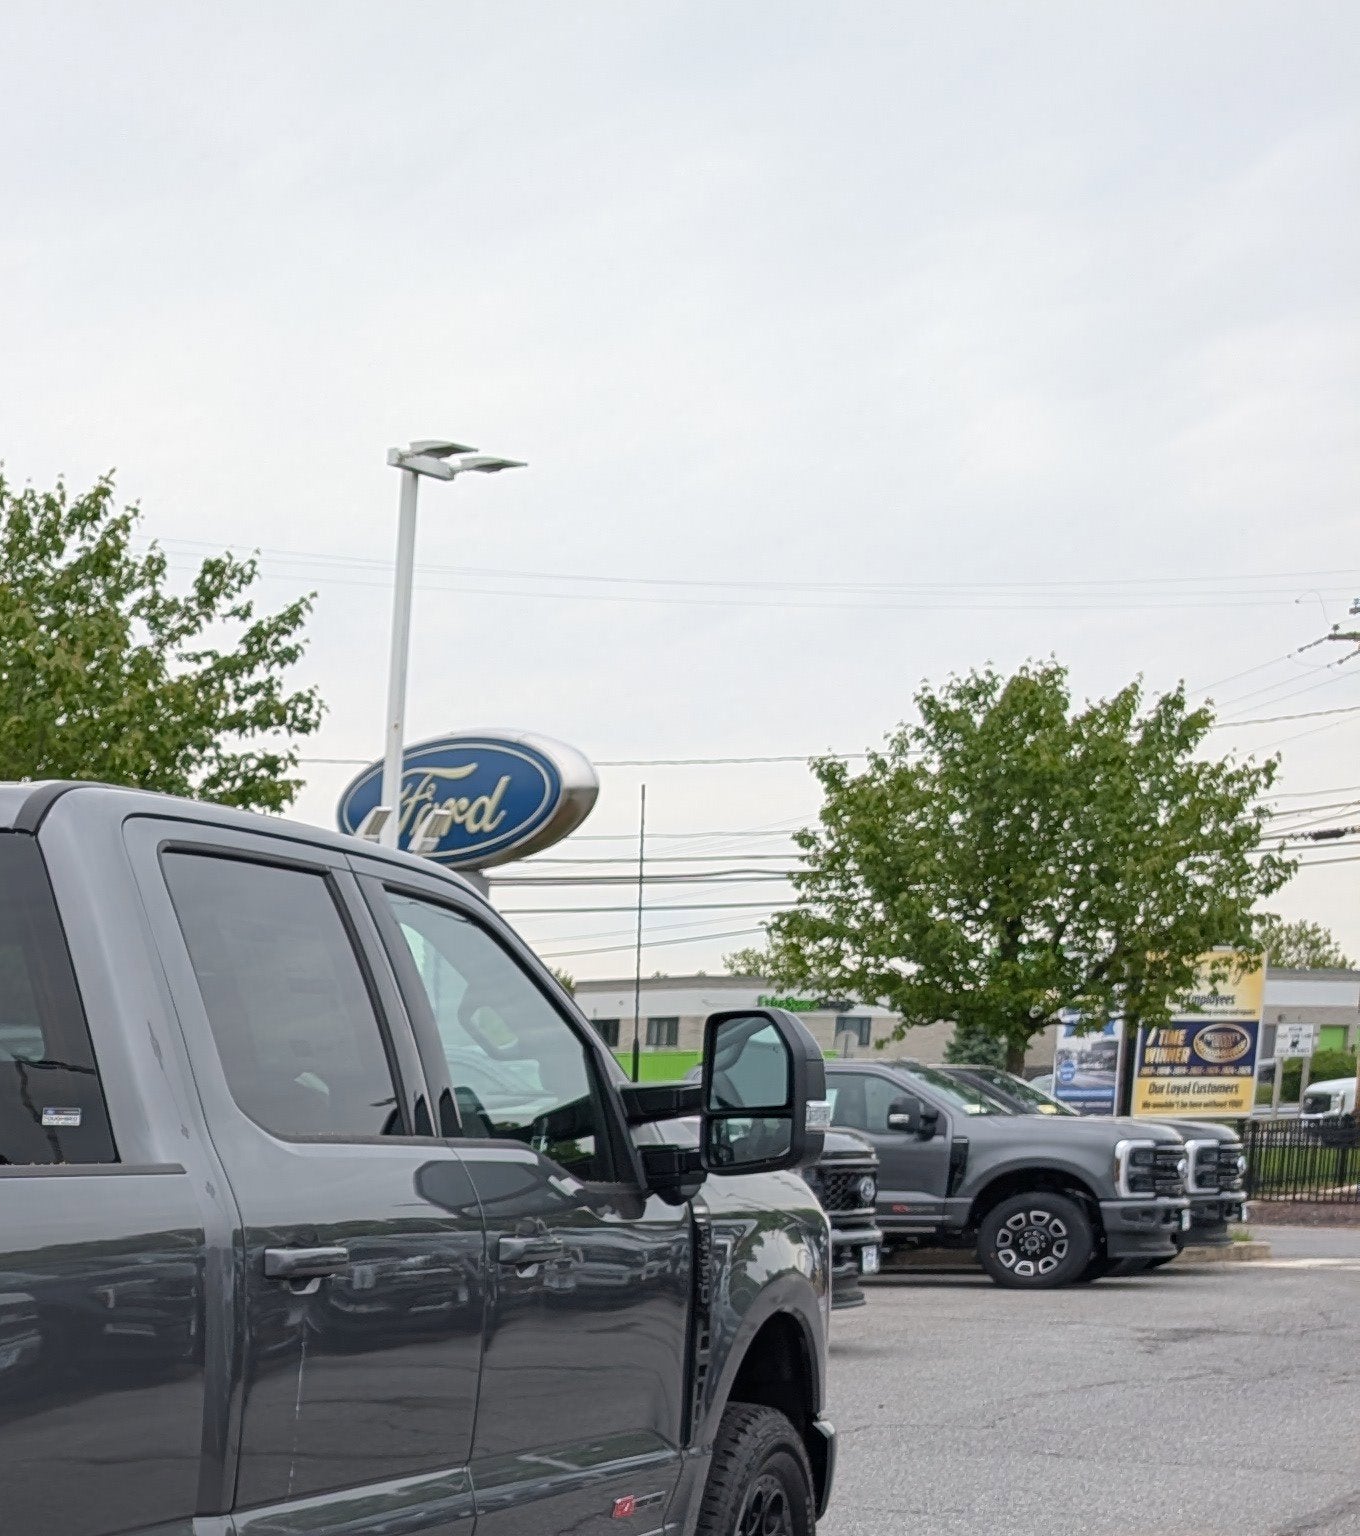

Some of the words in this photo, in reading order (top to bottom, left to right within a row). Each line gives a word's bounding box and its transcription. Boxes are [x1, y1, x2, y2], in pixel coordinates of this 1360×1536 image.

[1148, 1081, 1165, 1095] Our
[1167, 1081, 1191, 1096] Loyal
[1192, 1081, 1240, 1095] Customers
